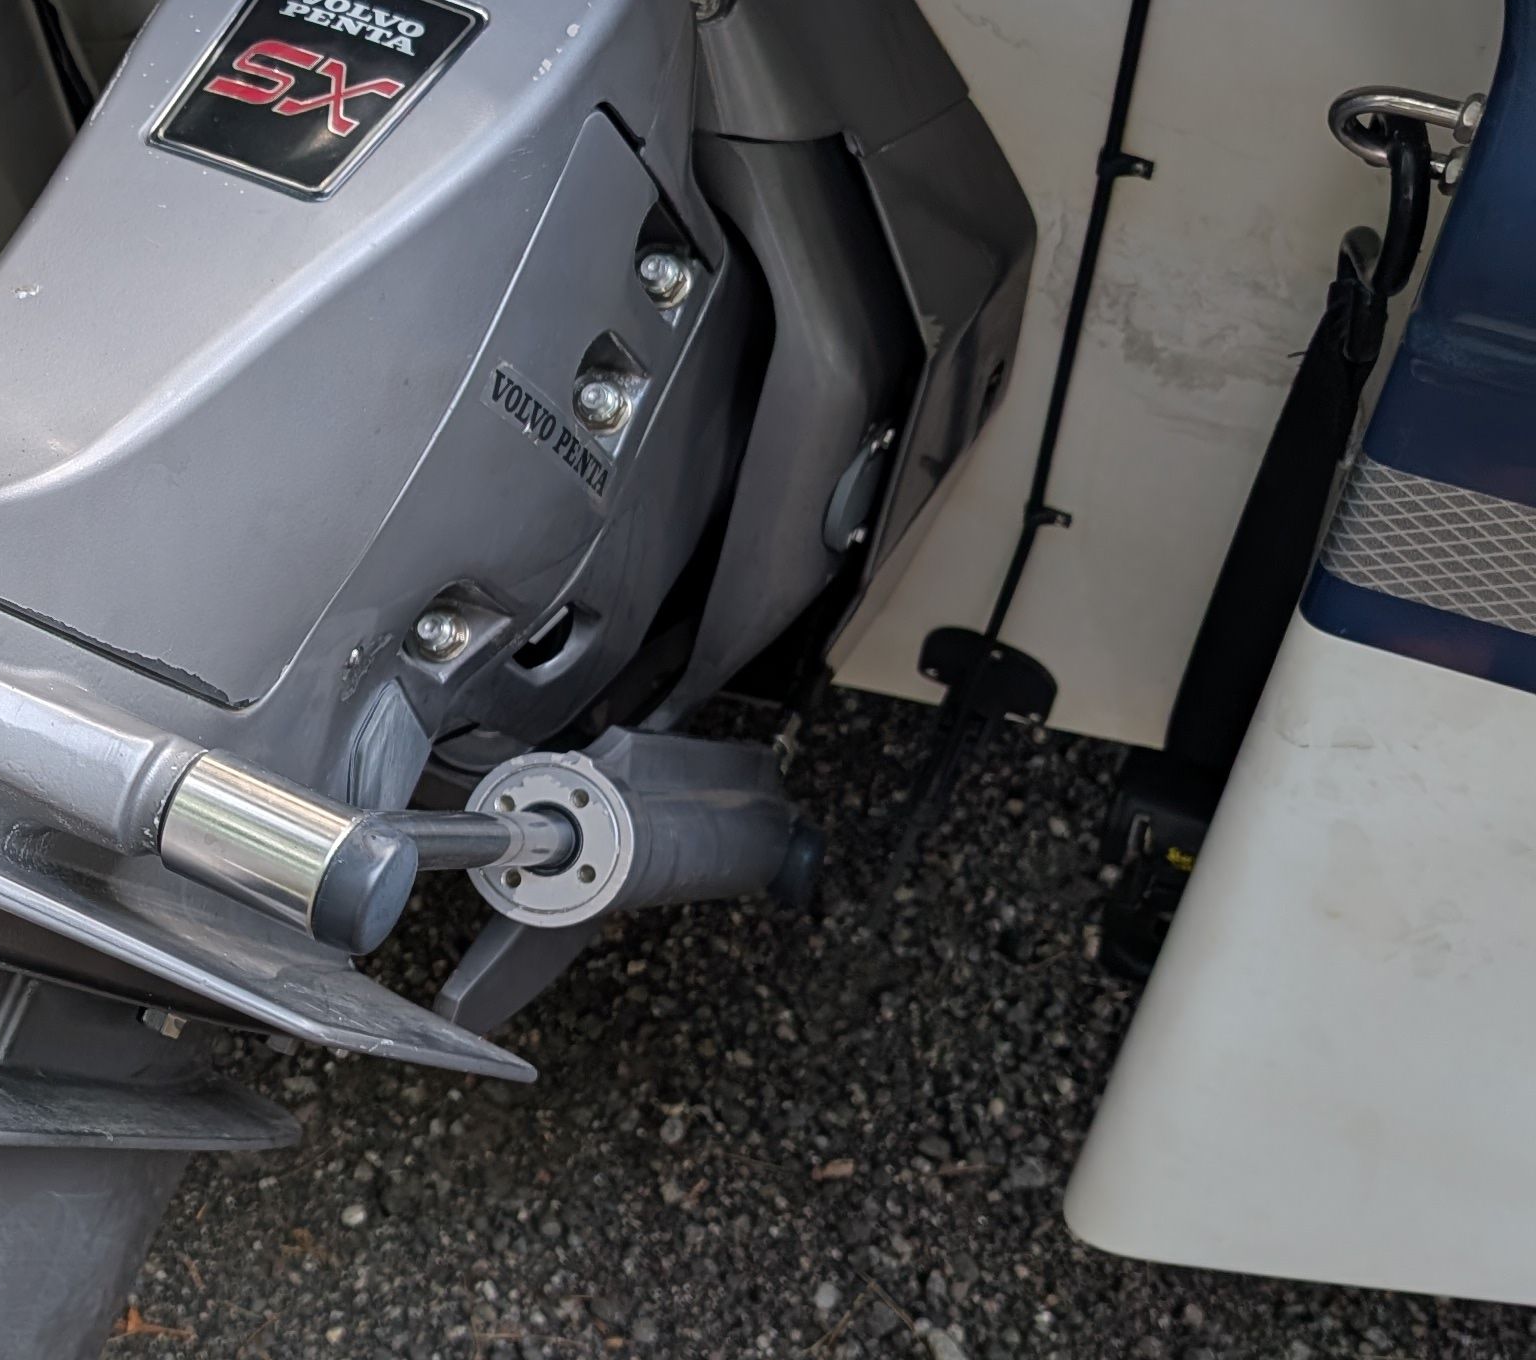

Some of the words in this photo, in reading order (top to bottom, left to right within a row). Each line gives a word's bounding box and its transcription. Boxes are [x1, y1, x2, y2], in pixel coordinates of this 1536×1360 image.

[279, 0, 416, 57] PENTA
[203, 40, 405, 137] SX
[490, 369, 557, 441] VOLVO
[552, 425, 609, 497] PENTA
